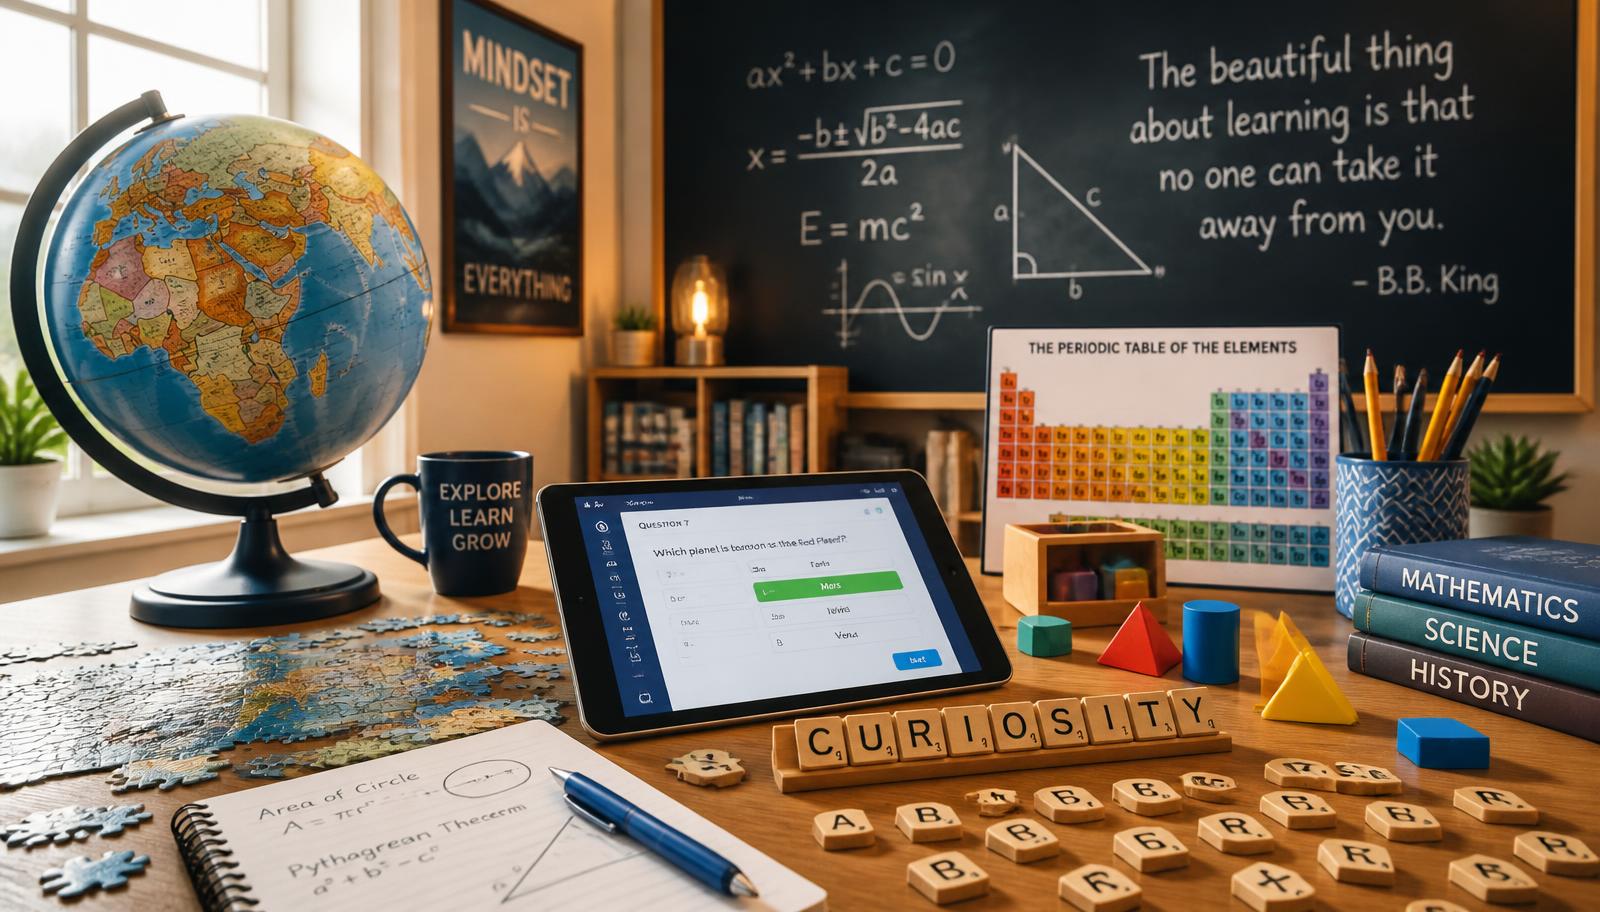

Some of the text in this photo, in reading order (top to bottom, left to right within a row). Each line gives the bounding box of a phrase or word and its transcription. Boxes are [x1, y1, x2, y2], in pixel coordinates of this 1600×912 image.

[463, 29, 572, 110] MINDSET
[1139, 30, 1454, 90] The beautiful thing
[512, 106, 530, 132] IS
[1130, 85, 1475, 144] about learning is that
[861, 158, 899, 186] 2a
[1159, 143, 1439, 192] no one can take it
[993, 204, 1009, 222] a
[1199, 199, 1445, 252] away from you.
[463, 262, 573, 303] EVERYTHING
[1069, 277, 1083, 300] b
[1377, 265, 1432, 297] B.B.
[1441, 265, 1500, 305] King
[1029, 341, 1298, 355] THE PERIODIC TABLE OF THE ELEMENTS
[440, 481, 522, 501] EXPLORE
[450, 506, 513, 526] LEARN
[452, 532, 511, 551] GROW
[653, 547, 687, 557] Which
[1401, 567, 1579, 624] MATHEMATICS
[1424, 617, 1539, 667] SCIENCE
[1410, 658, 1530, 712] HISTORY
[808, 696, 1202, 756] CURIOSITY
[259, 773, 420, 820] Area of Circle
[832, 814, 855, 831] A
